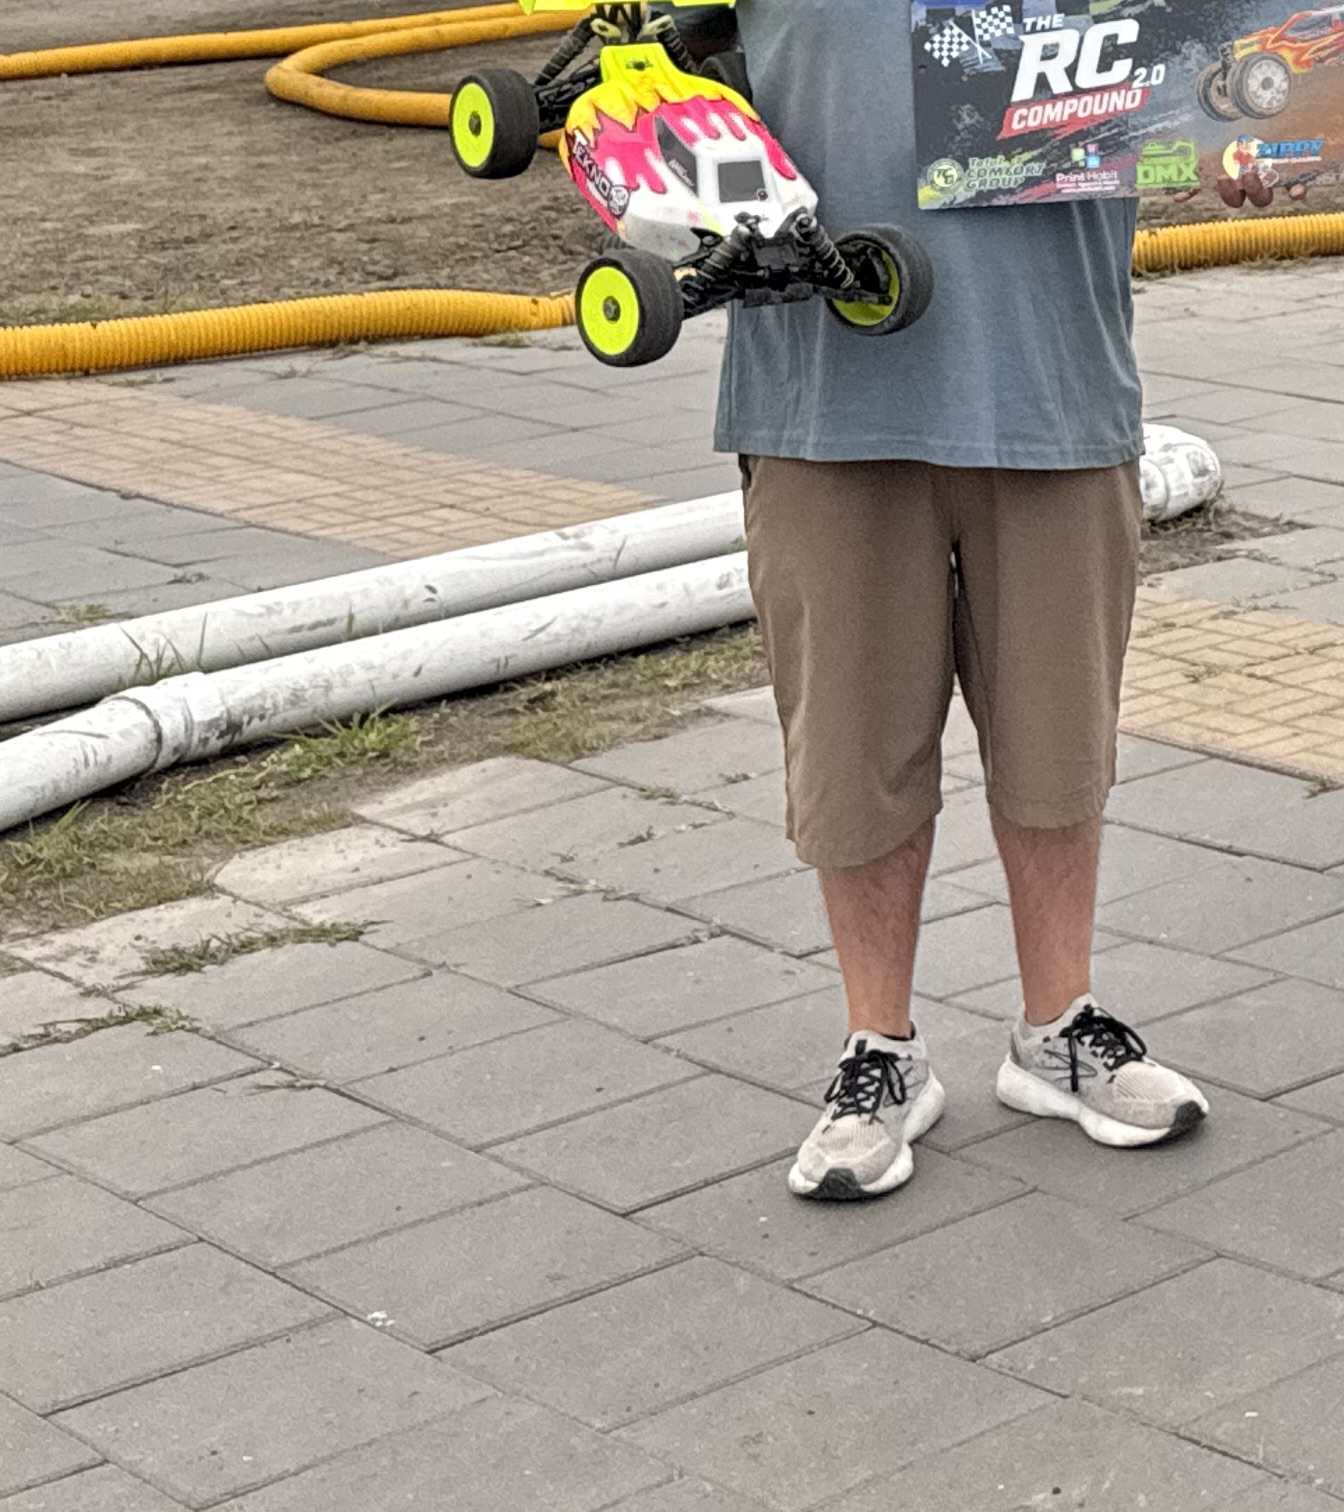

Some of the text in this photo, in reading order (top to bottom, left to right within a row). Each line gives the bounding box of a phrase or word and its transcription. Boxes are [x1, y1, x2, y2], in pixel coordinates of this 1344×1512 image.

[1023, 13, 1065, 32] THE
[1011, 18, 1140, 102] RC
[1131, 64, 1166, 88] 2.0
[1011, 89, 1142, 131] COMPOUND
[571, 129, 612, 201] TEKNO
[966, 163, 1046, 179] COMFORT
[1136, 162, 1198, 184] DMX
[965, 175, 1025, 190] GROUP
[1056, 171, 1085, 183] Print
